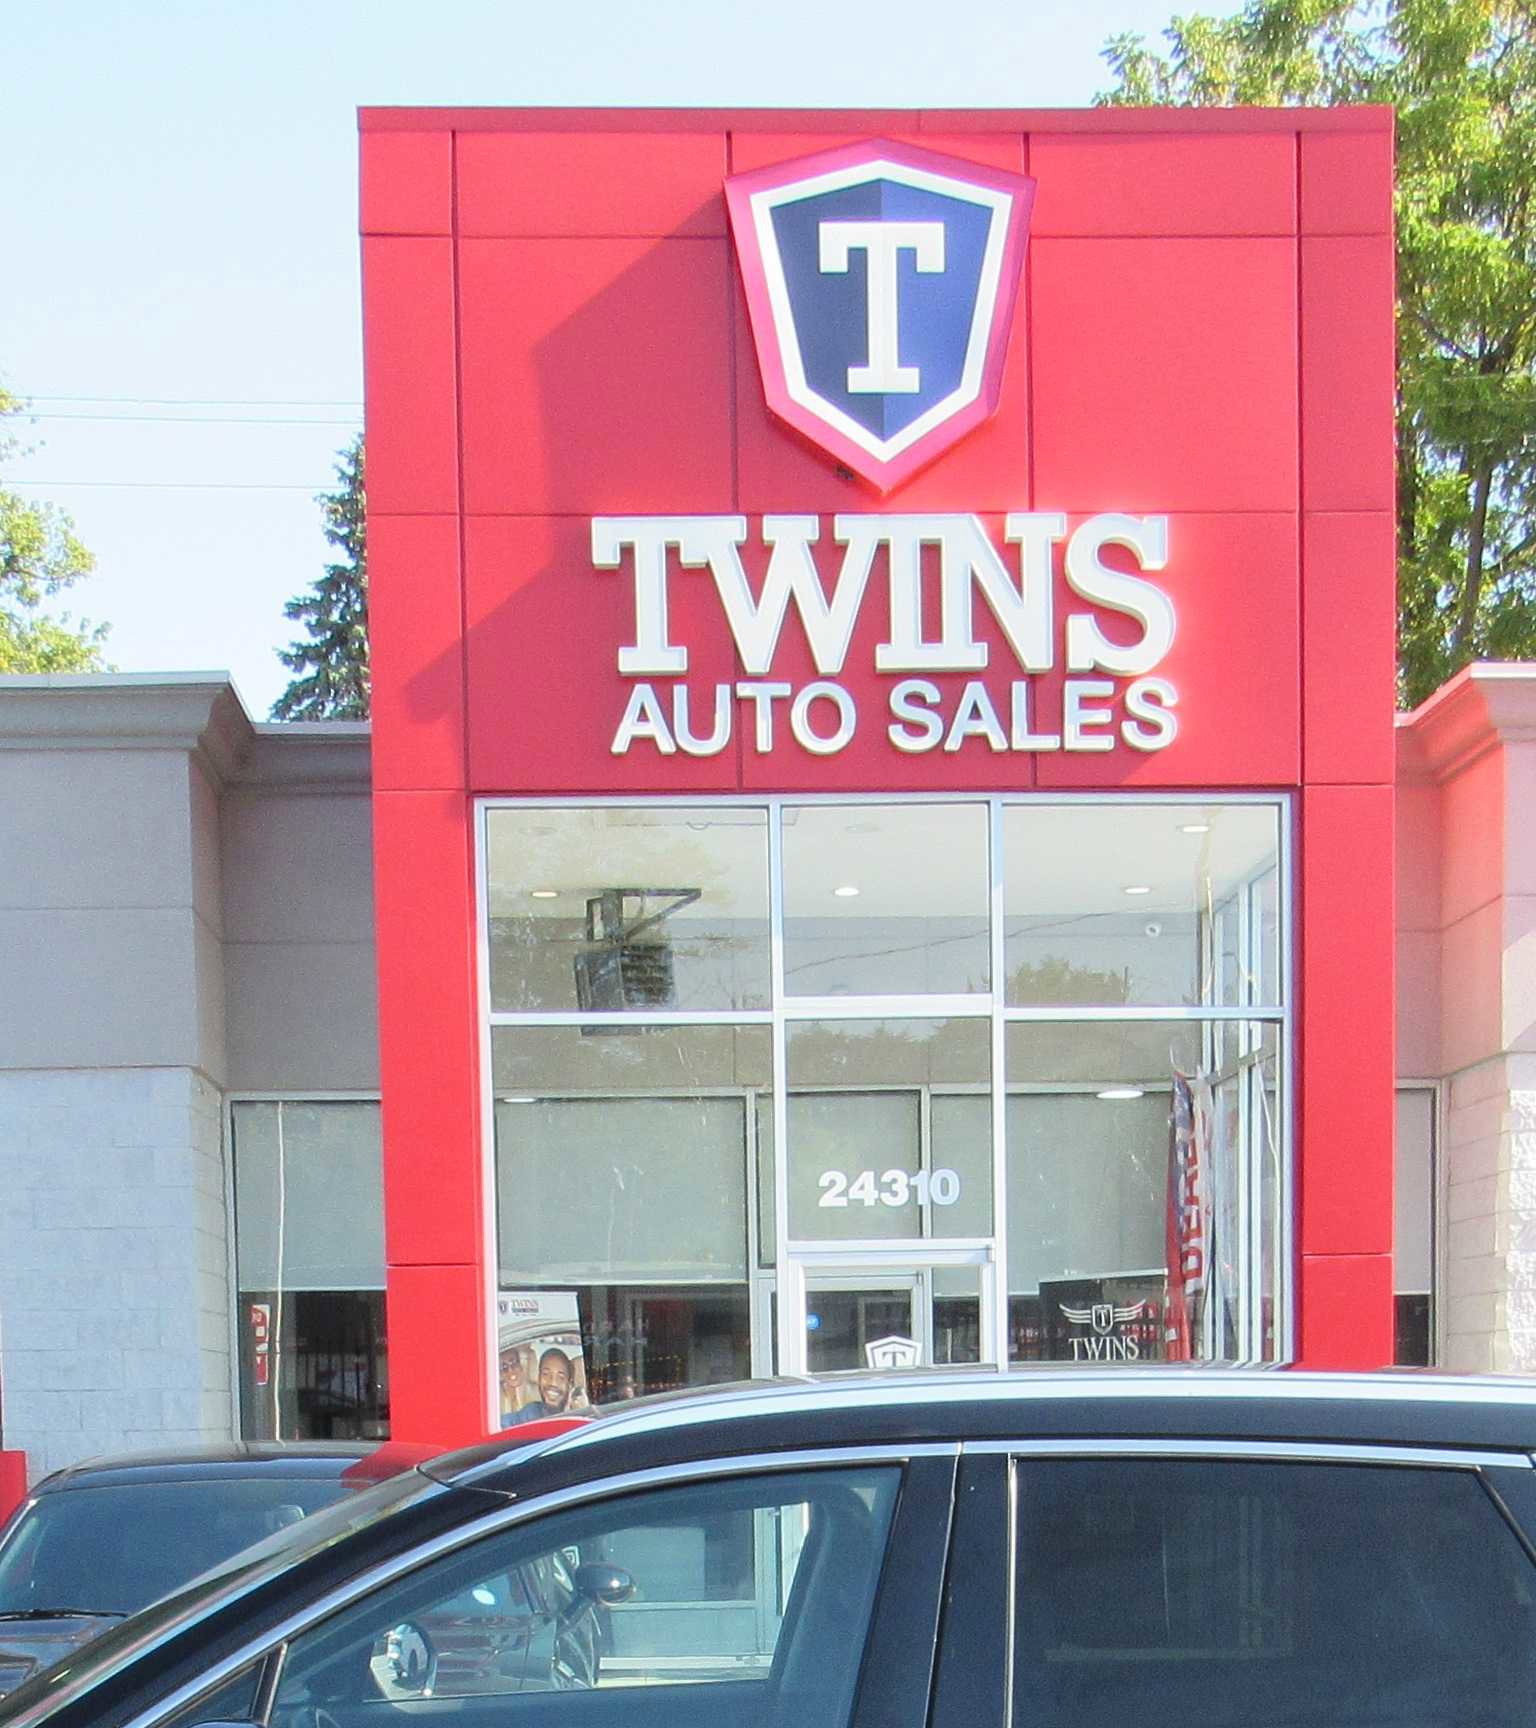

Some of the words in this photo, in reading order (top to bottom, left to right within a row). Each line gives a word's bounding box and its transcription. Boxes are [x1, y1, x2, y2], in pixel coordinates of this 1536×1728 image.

[819, 222, 945, 393] T
[591, 512, 1176, 676] TWINS
[610, 681, 856, 756] AUTO
[887, 679, 1178, 753] SALES
[818, 1168, 960, 1208] 24310
[1068, 1334, 1141, 1361] TWINS
